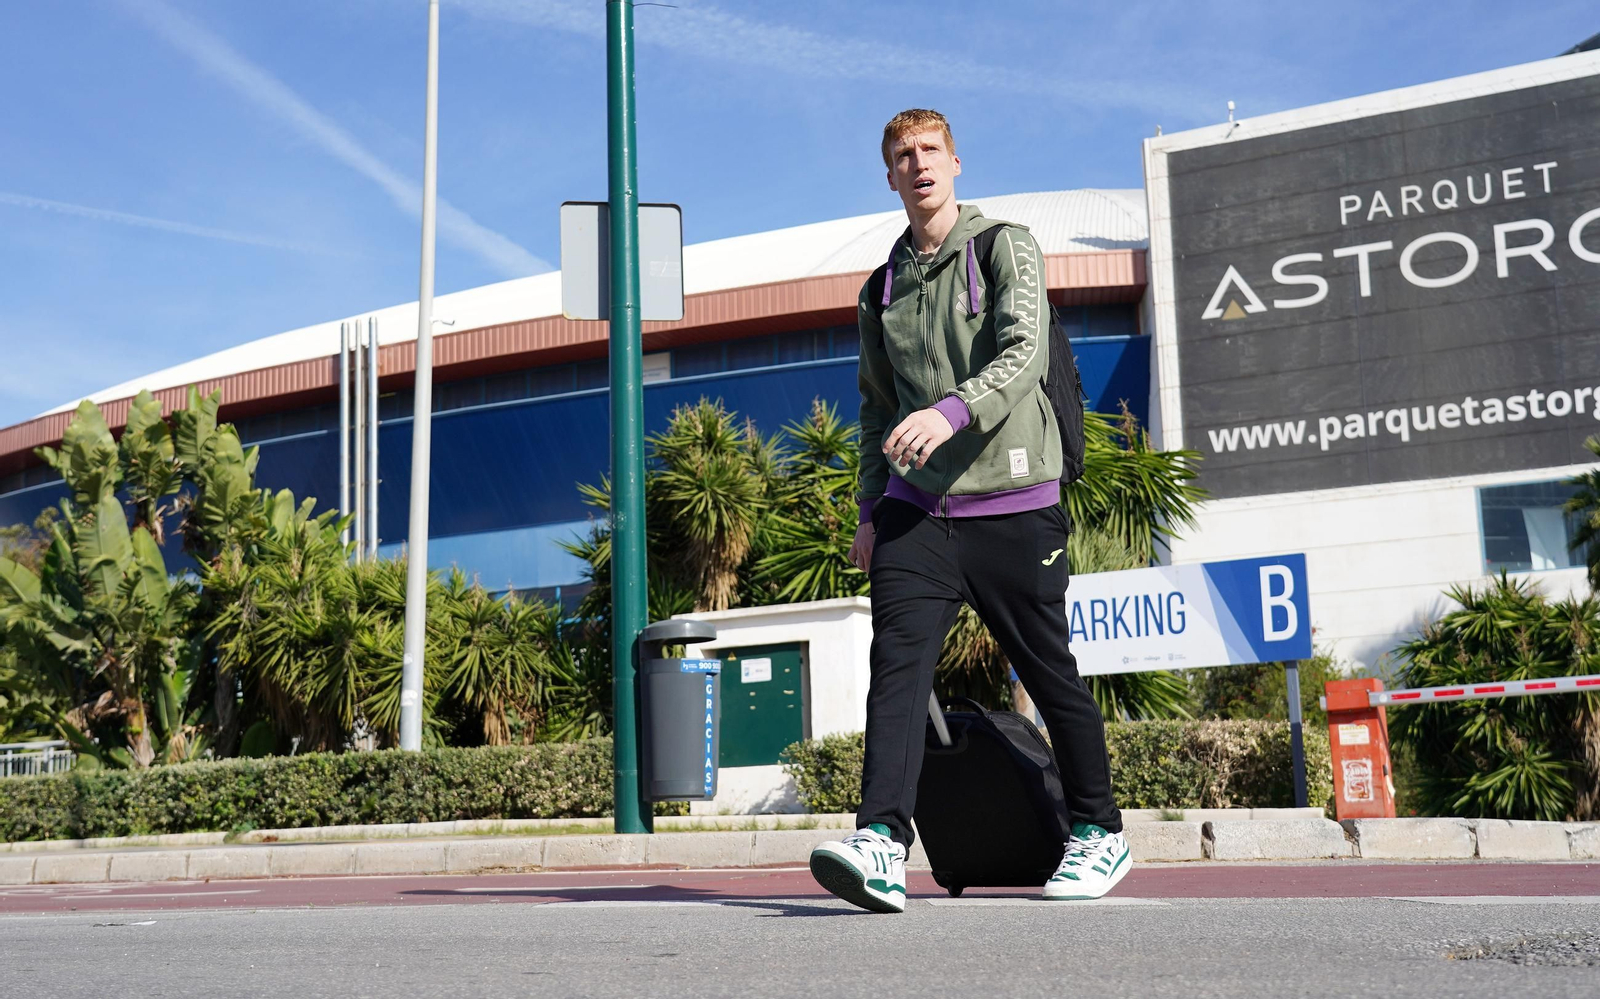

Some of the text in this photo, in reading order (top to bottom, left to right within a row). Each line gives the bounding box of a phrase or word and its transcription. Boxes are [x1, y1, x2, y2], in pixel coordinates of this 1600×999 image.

[1339, 161, 1559, 226] PARQUET
[1068, 564, 1299, 643] ARKING B
[698, 662, 712, 670] 900
